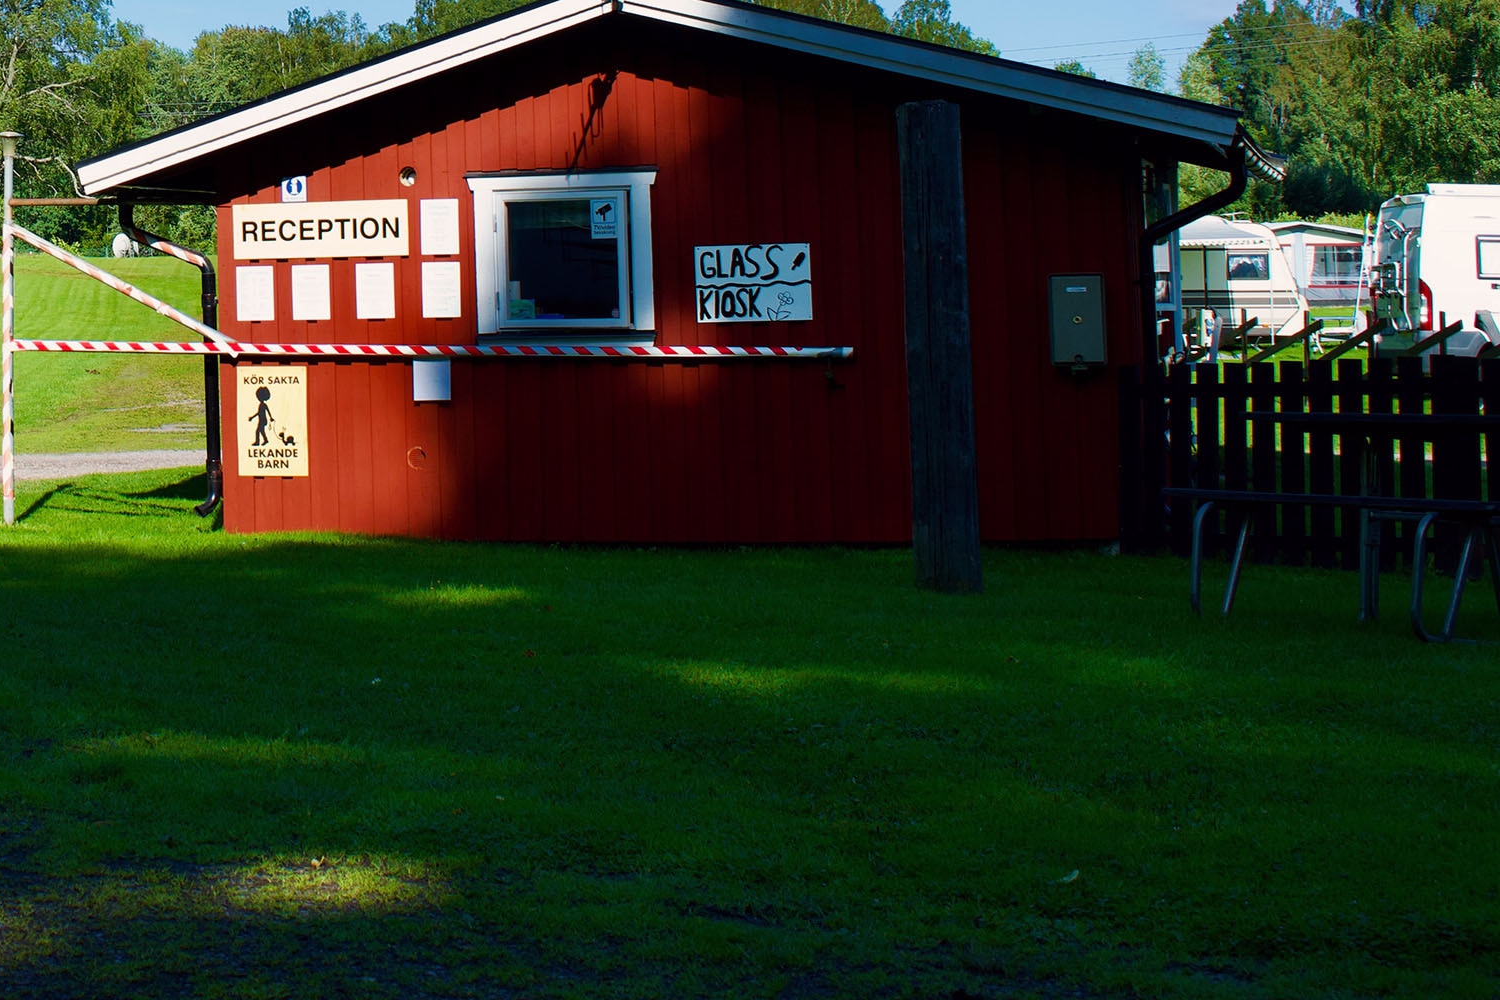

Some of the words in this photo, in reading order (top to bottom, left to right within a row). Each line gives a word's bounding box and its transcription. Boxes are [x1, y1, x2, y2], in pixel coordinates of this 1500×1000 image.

[242, 217, 400, 242] RECEPTION
[700, 244, 784, 280] GLASS
[699, 286, 762, 321] KIOSK
[243, 374, 265, 385] KÖR
[268, 376, 300, 385] SAKTA
[248, 448, 299, 458] LEKANDE
[257, 459, 290, 469] BARN
